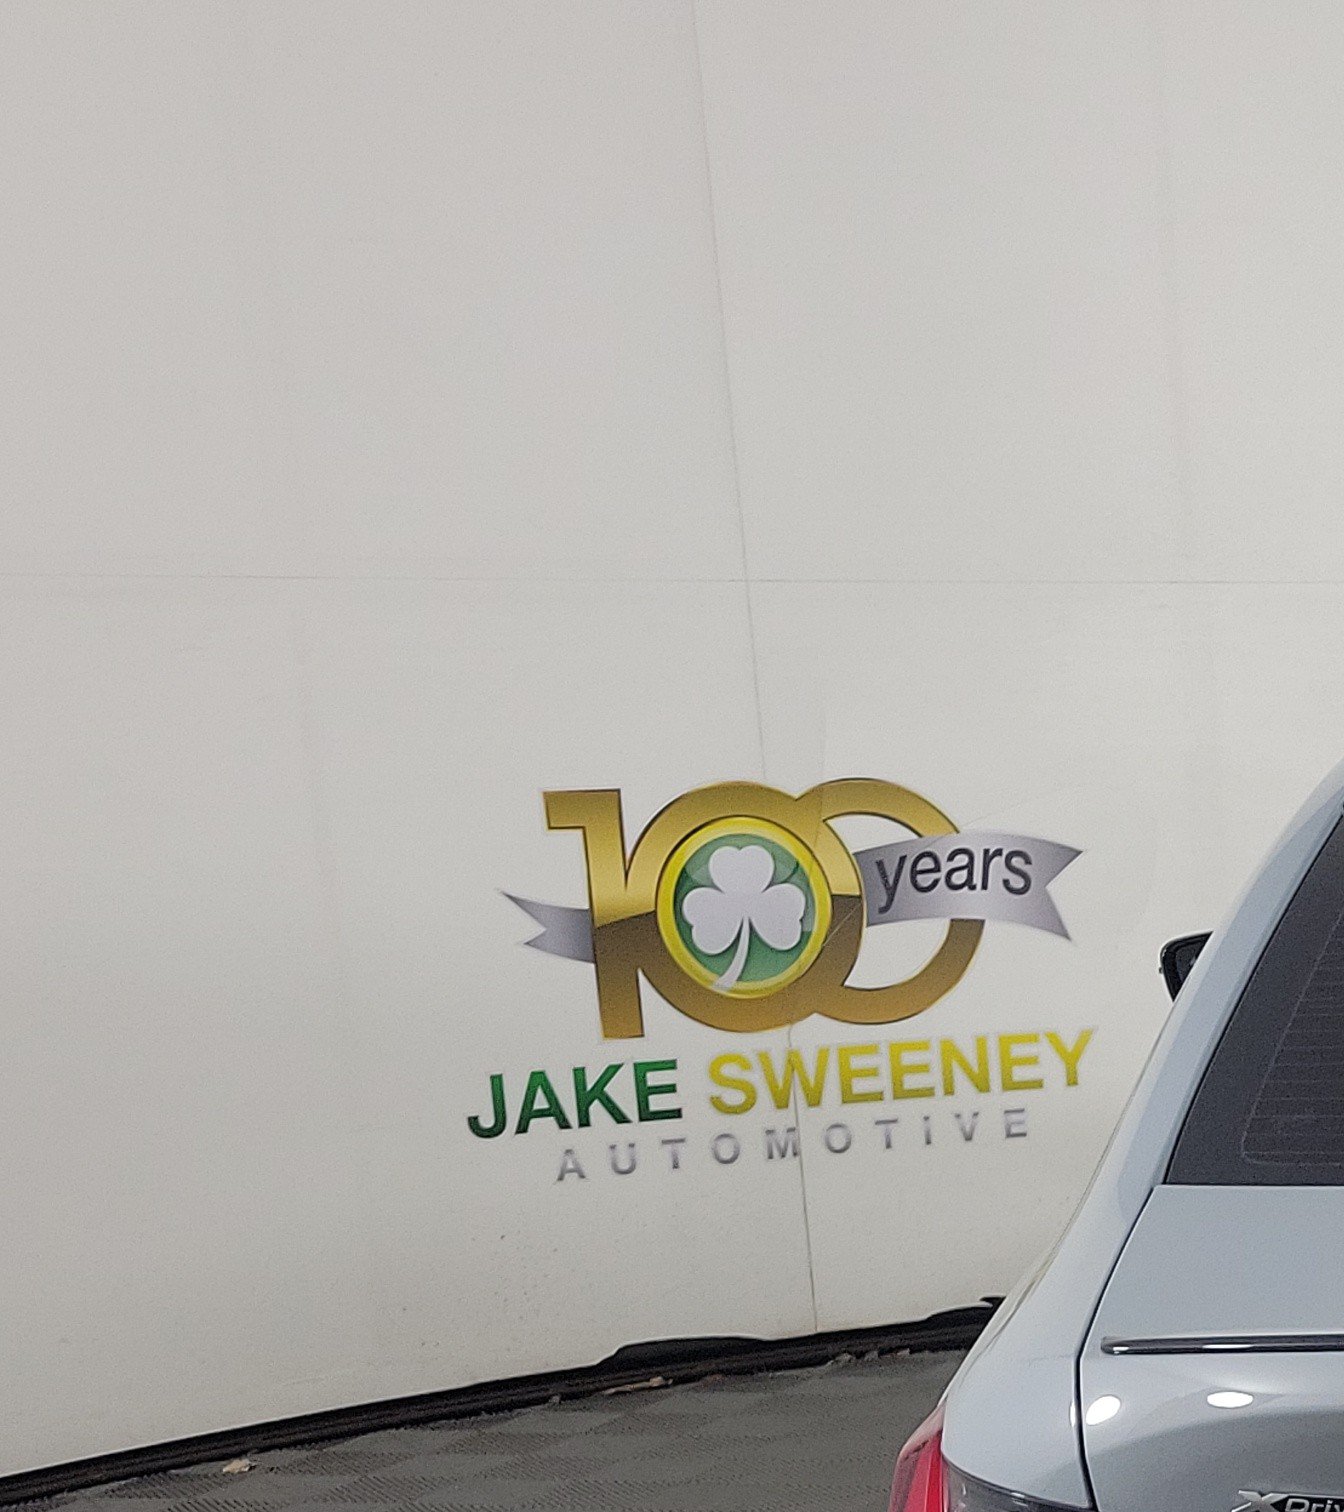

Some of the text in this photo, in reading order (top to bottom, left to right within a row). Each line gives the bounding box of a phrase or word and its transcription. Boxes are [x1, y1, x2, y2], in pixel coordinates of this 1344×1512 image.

[543, 777, 985, 1041] 100
[876, 844, 1033, 914] years
[466, 1029, 1096, 1140] JAKE SWEENEY
[556, 1107, 1030, 1184] AUTOMOTIVE
